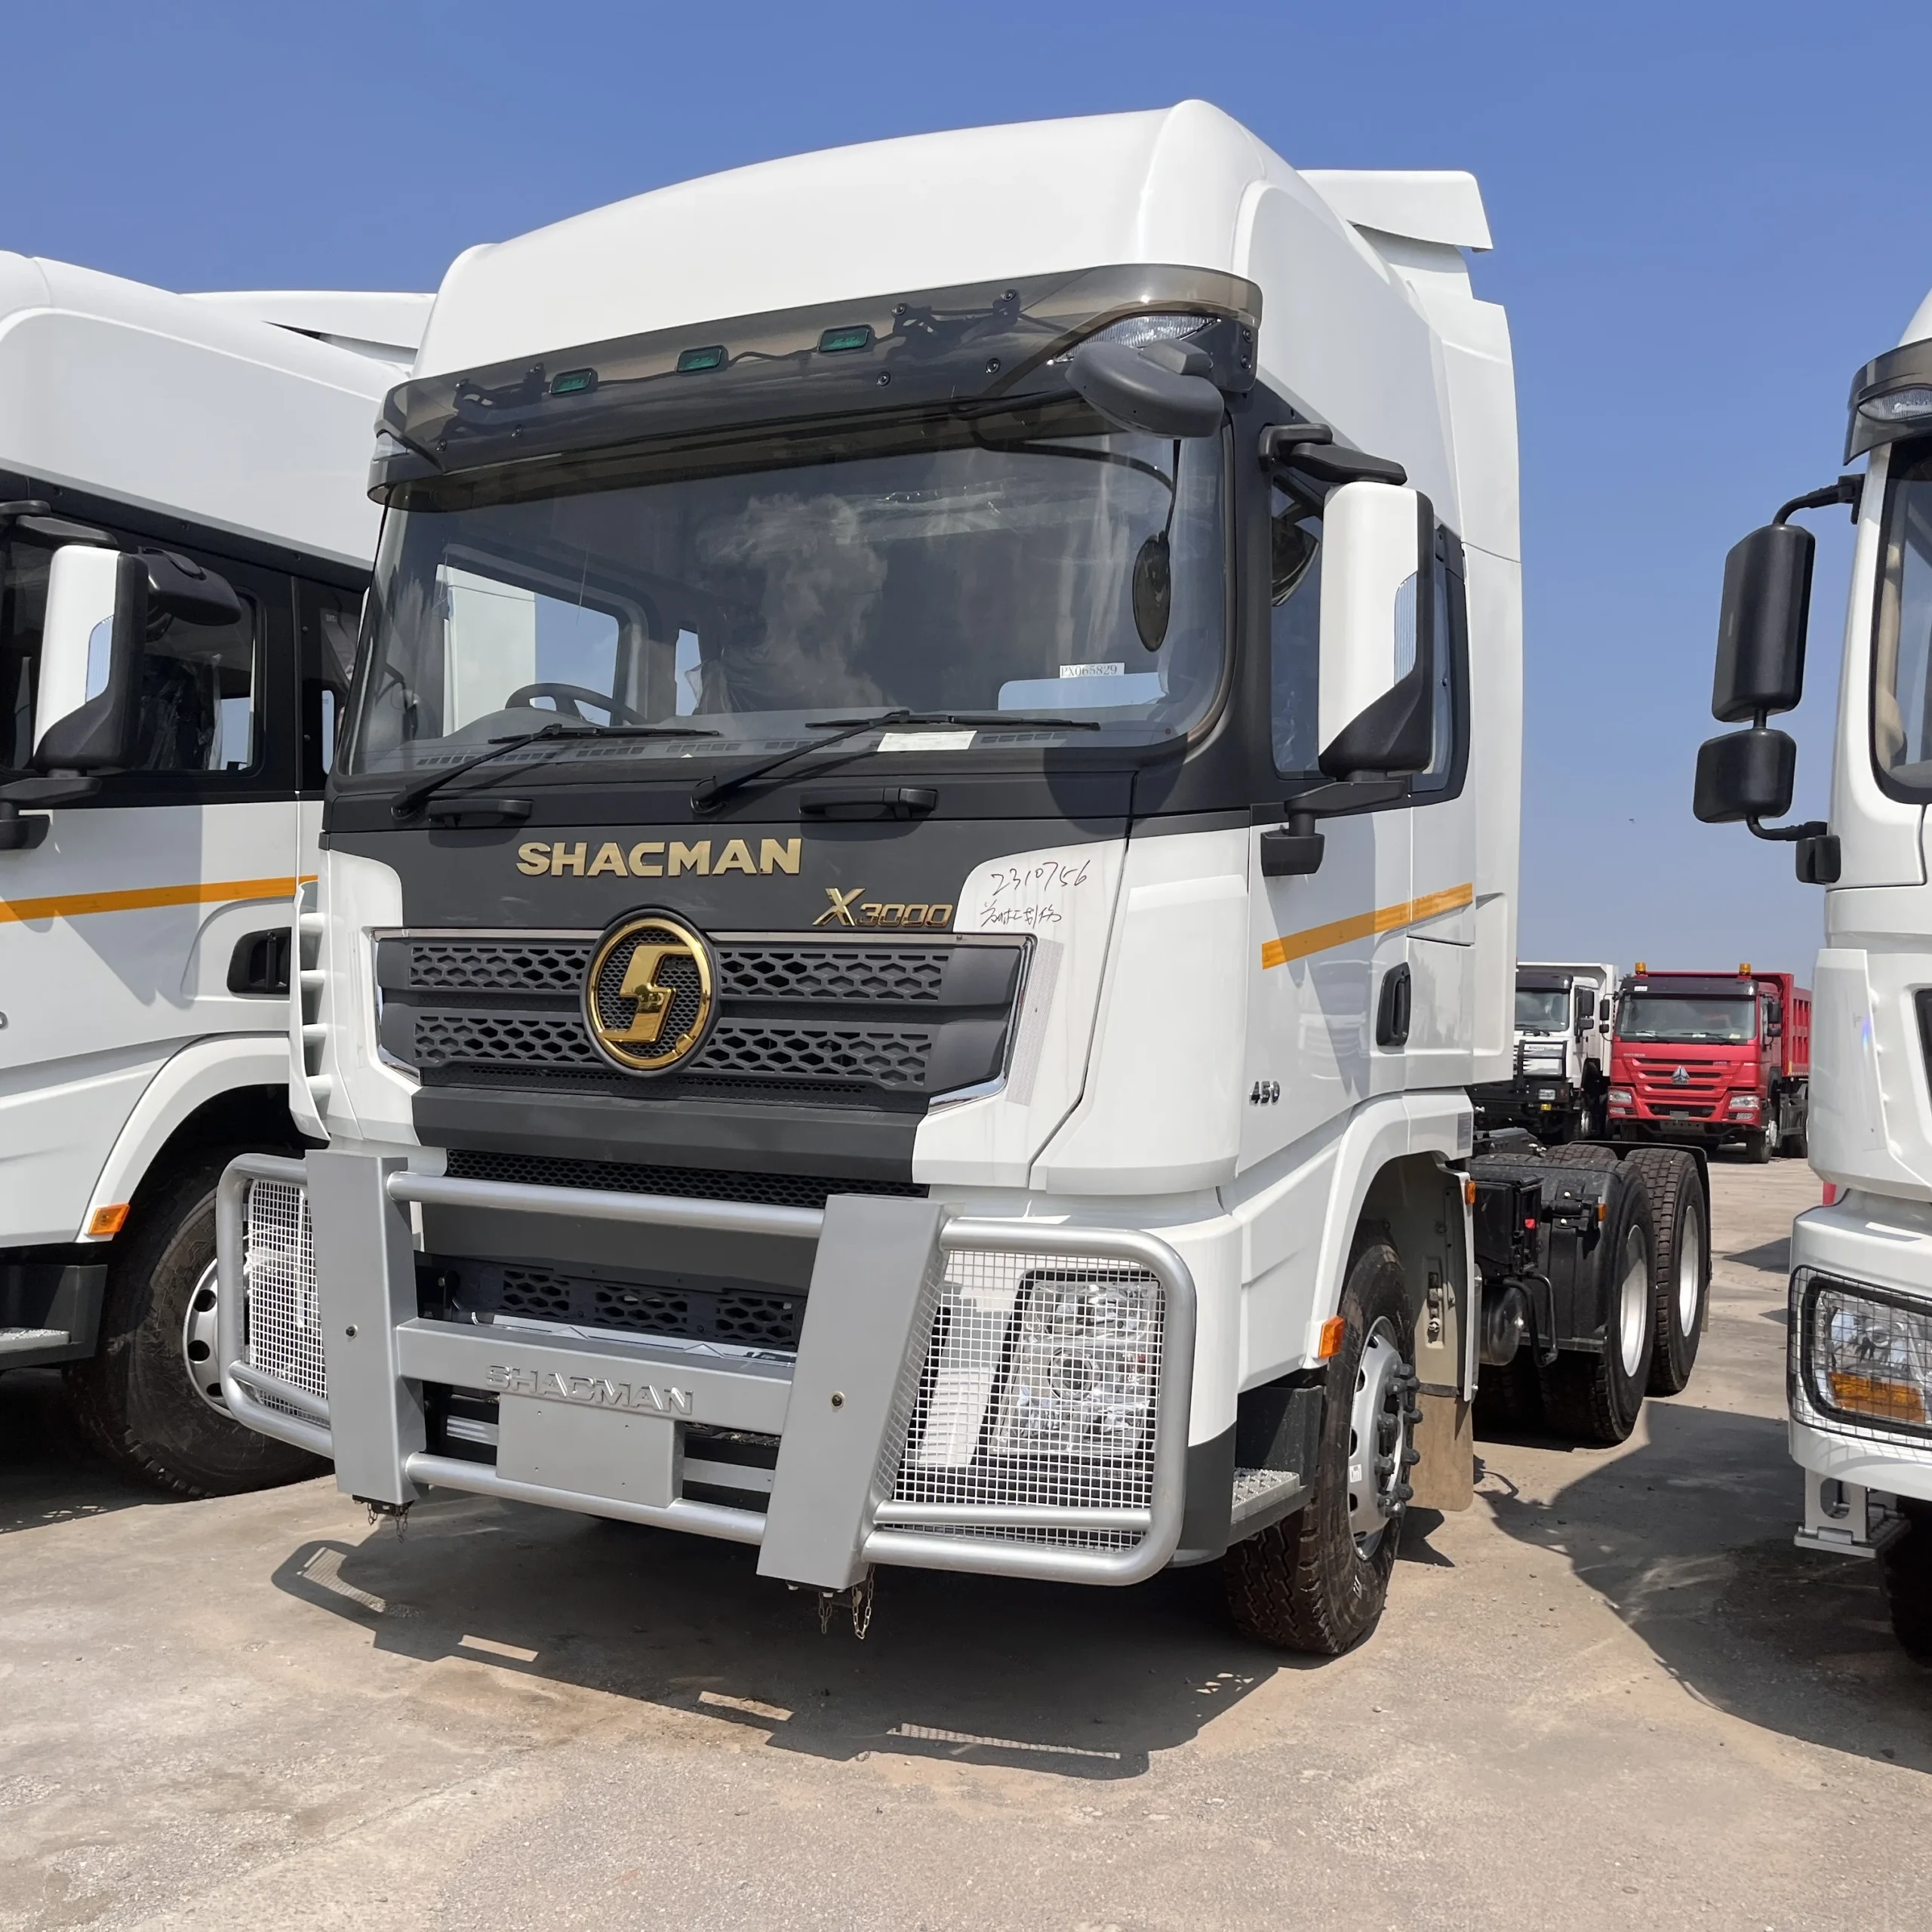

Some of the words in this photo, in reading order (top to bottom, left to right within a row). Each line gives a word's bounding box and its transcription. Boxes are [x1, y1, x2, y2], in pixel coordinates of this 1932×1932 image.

[1060, 664, 1117, 677] PX065829
[516, 838, 802, 876] SHACMAN
[991, 860, 1091, 896] 2310756
[812, 888, 954, 927] X3000
[1249, 1081, 1281, 1106] 450
[485, 1364, 694, 1414] SHACMAN
